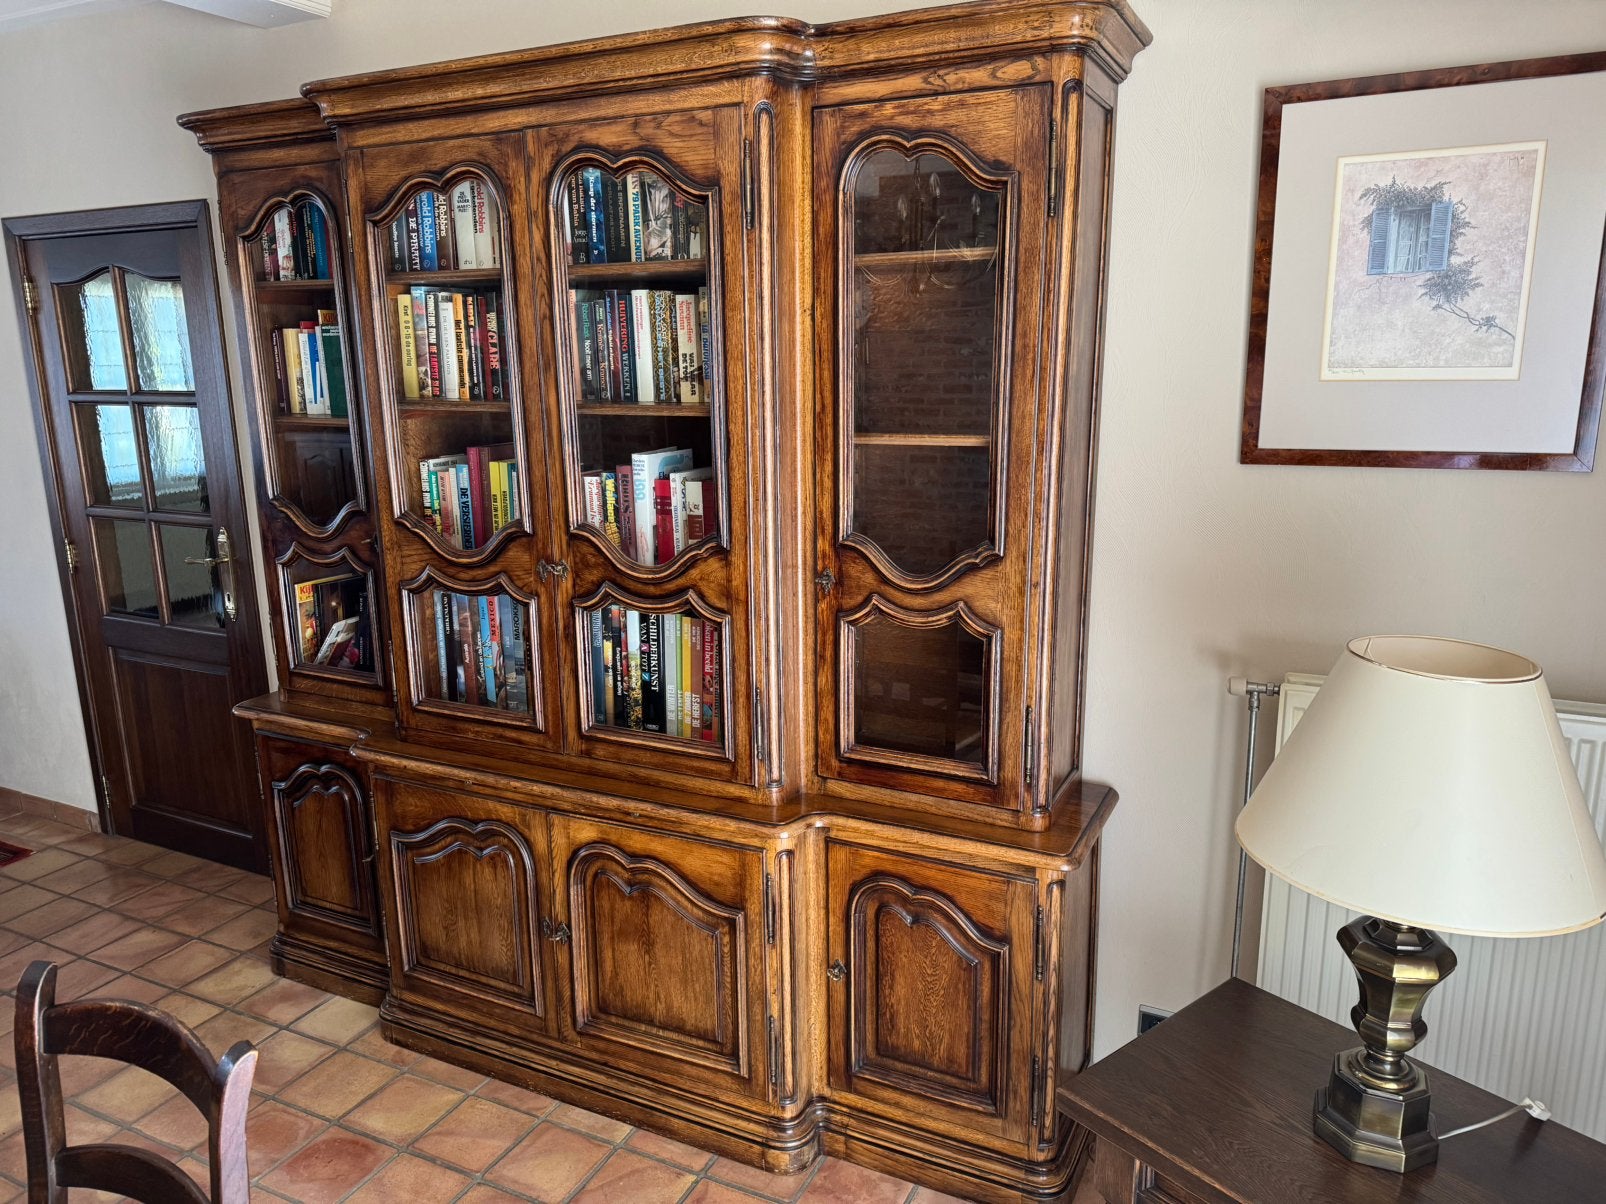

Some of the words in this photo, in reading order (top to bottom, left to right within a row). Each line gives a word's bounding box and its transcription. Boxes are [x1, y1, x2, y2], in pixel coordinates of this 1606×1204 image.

[632, 192, 640, 202] 79
[408, 218, 416, 230] DE
[476, 201, 486, 234] Robbins
[632, 204, 641, 228] PARK
[423, 218, 432, 254] Robbins
[634, 228, 642, 262] AVENUE
[410, 232, 420, 270] PIRAAT
[426, 294, 436, 327] CORNELIUS
[685, 300, 694, 344] Jacqueline
[428, 328, 436, 344] RYAN
[619, 300, 629, 352] HUIVERING
[488, 332, 500, 370] CLARE
[430, 354, 439, 379] LAATSTE
[458, 355, 467, 389] commando
[420, 462, 430, 492] CORNELIUS
[422, 492, 432, 508] RYAN
[460, 488, 468, 500] DE
[606, 479, 616, 523] Wallace
[488, 600, 497, 636] MEXICO
[642, 644, 649, 652] A
[650, 614, 659, 692] SCHILDERKUNST
[706, 642, 712, 650] in
[642, 672, 650, 680] Z
[667, 684, 676, 711] WINTER
[692, 694, 700, 718] HERFST
[668, 711, 675, 720] DE
[692, 718, 700, 728] DE
